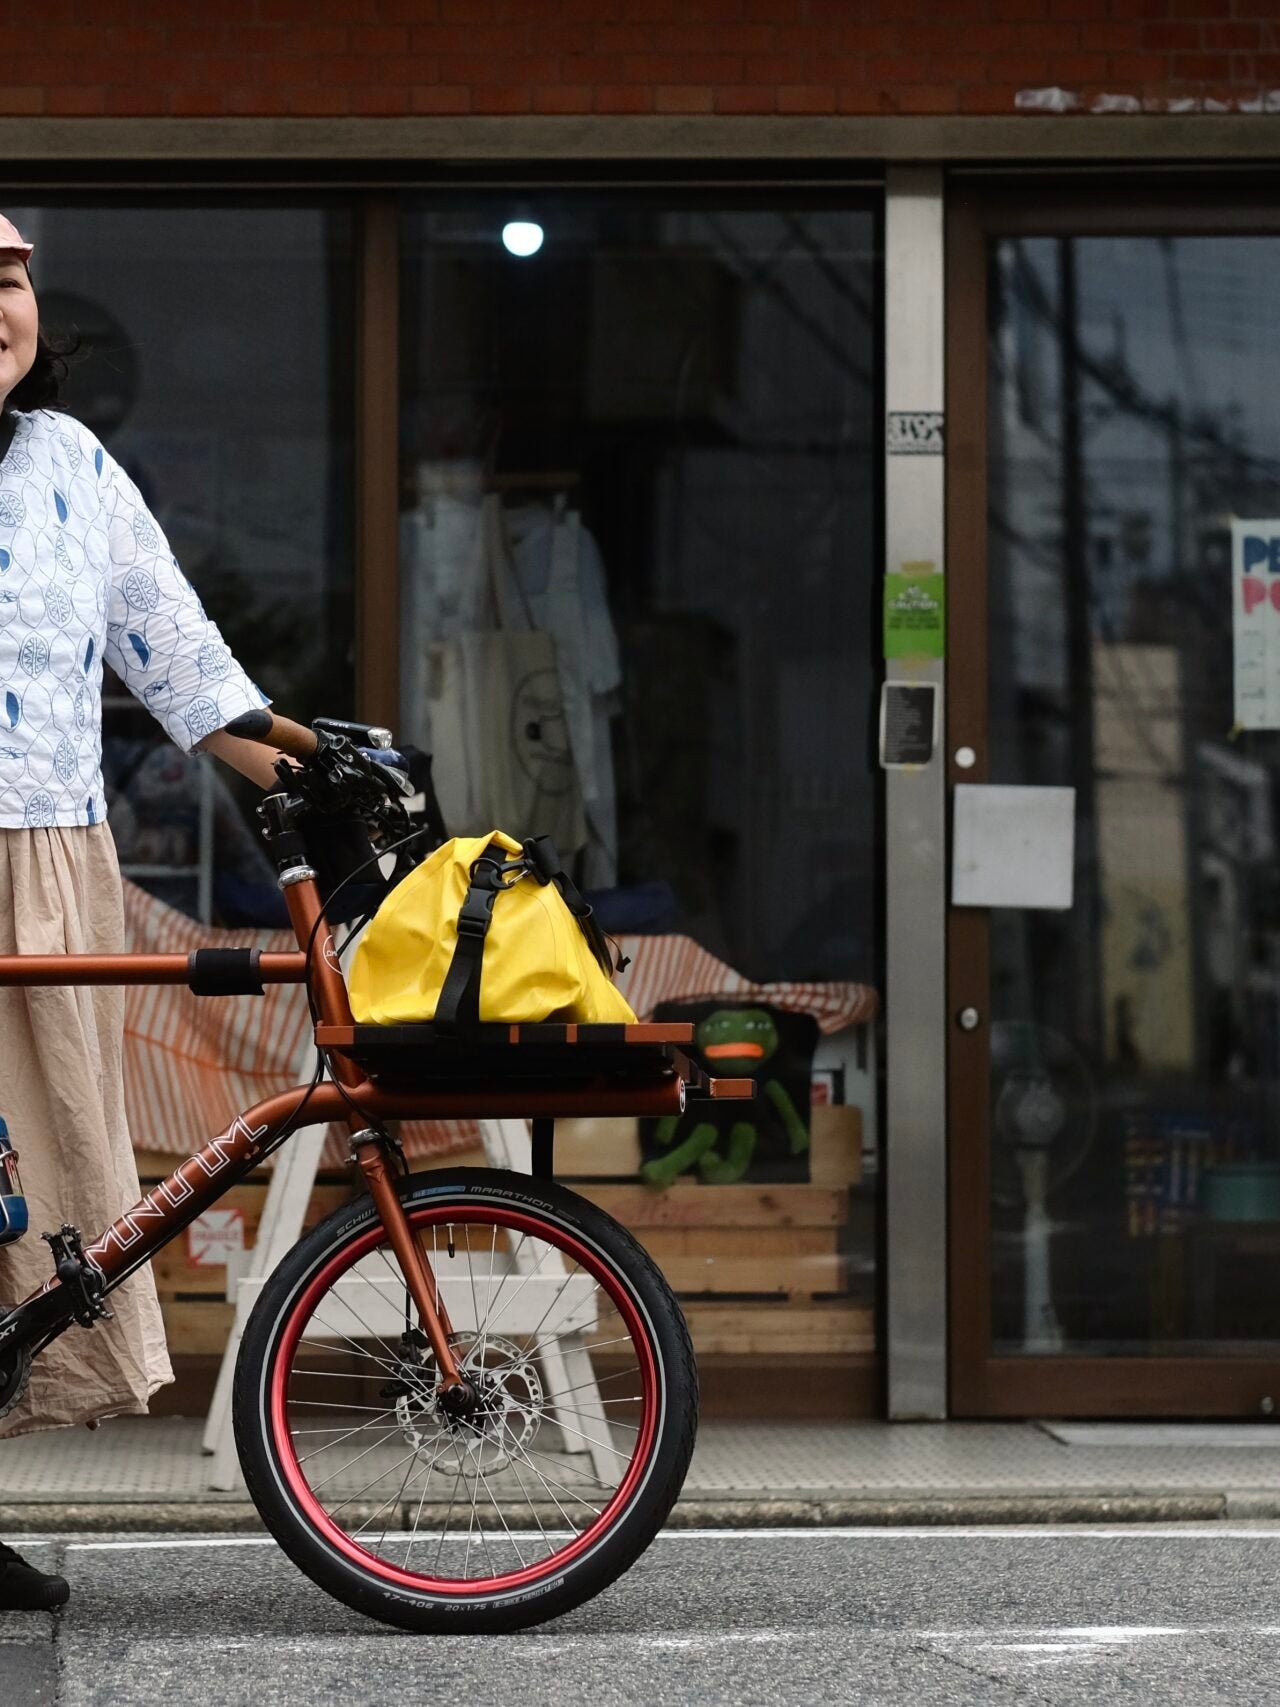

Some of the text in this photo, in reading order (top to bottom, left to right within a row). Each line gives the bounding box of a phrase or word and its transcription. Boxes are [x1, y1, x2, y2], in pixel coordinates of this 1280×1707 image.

[44, 1116, 269, 1298] MNIUM
[470, 1185, 555, 1212] MARATHON
[382, 1591, 434, 1610] 47-406
